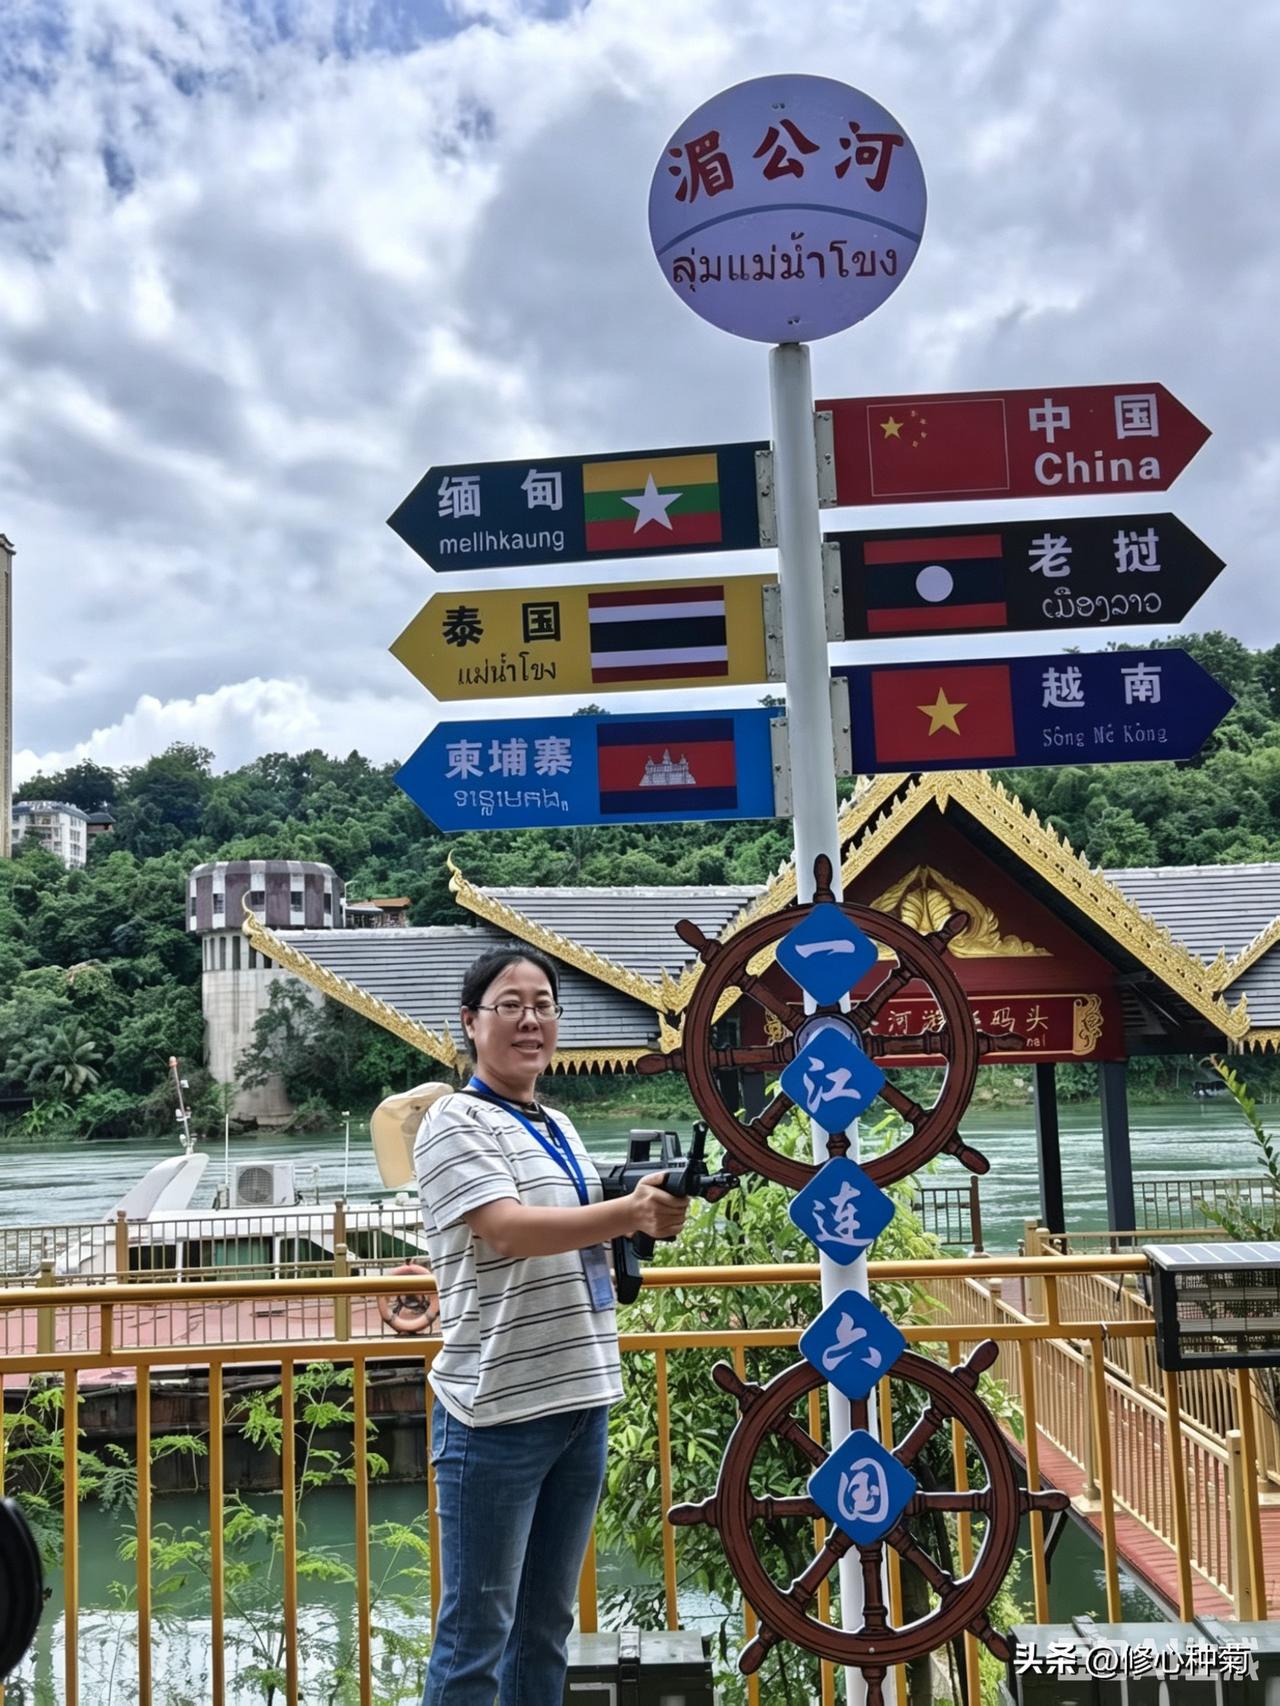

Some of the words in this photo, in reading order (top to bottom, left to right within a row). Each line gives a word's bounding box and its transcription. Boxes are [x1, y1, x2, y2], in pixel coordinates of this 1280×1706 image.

[667, 118, 905, 203] 湄公河
[1028, 393, 1160, 443] 中国
[1034, 450, 1161, 486] China
[437, 469, 563, 518] 缅甸
[440, 530, 565, 555] mellhkaung
[1028, 528, 1162, 579] 老挝
[442, 601, 562, 648] 泰国
[1042, 662, 1163, 709] 越南
[445, 736, 573, 780] 柬埔寨
[795, 939, 890, 1524] 一江连六国
